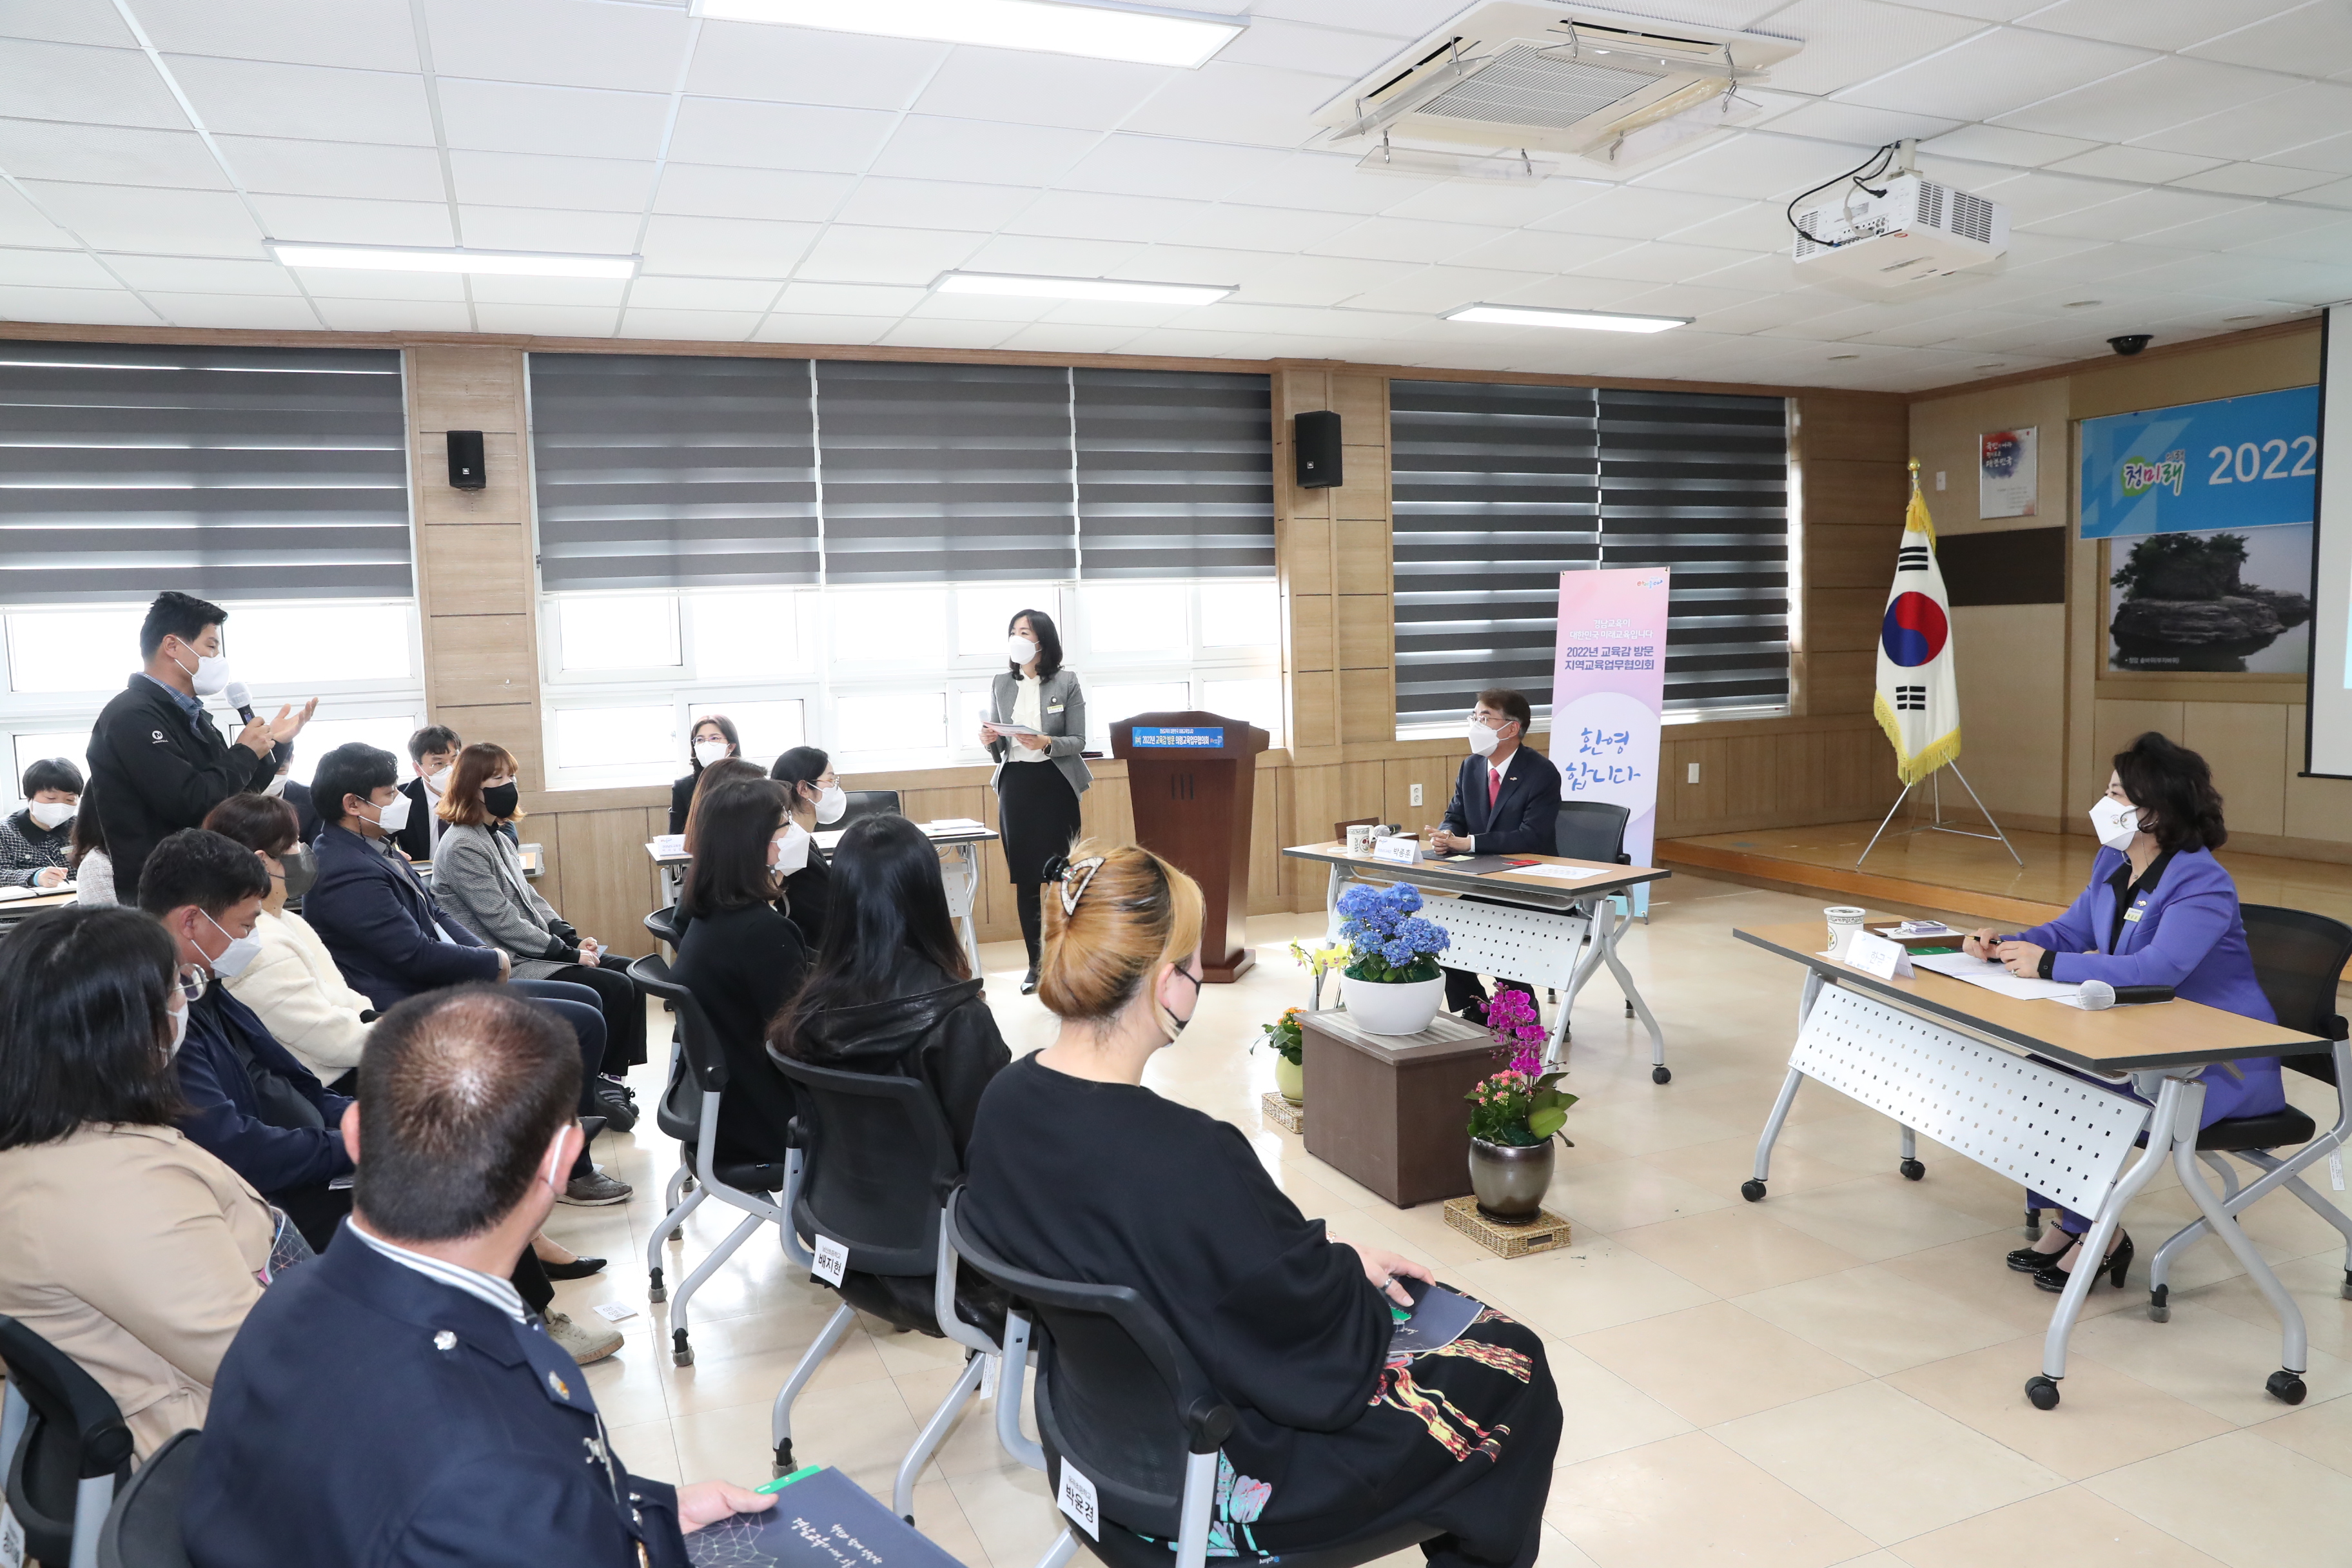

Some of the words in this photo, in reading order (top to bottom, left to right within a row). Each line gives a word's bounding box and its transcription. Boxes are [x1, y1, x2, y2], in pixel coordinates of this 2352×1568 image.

[2208, 435, 2317, 485] 2022
[1594, 619, 1631, 629] 경남교육이
[1569, 631, 1600, 640] 대한민국
[1600, 630, 1654, 640] 미래교육입니다
[1567, 647, 1598, 657] 2022년
[1601, 646, 1632, 657] 교육감
[1634, 646, 1654, 657] 방문
[1565, 660, 1654, 671] 지역교육업무협의회
[1142, 736, 1155, 745] 2022년
[1155, 736, 1167, 745] 교육감
[1167, 736, 1175, 745] 방문
[1580, 727, 1629, 755] 환영
[1565, 761, 1641, 791] 합니다
[1393, 847, 1411, 858] 박종훈
[818, 1253, 842, 1276] 배지현
[1066, 1484, 1093, 1523] 박윤경
